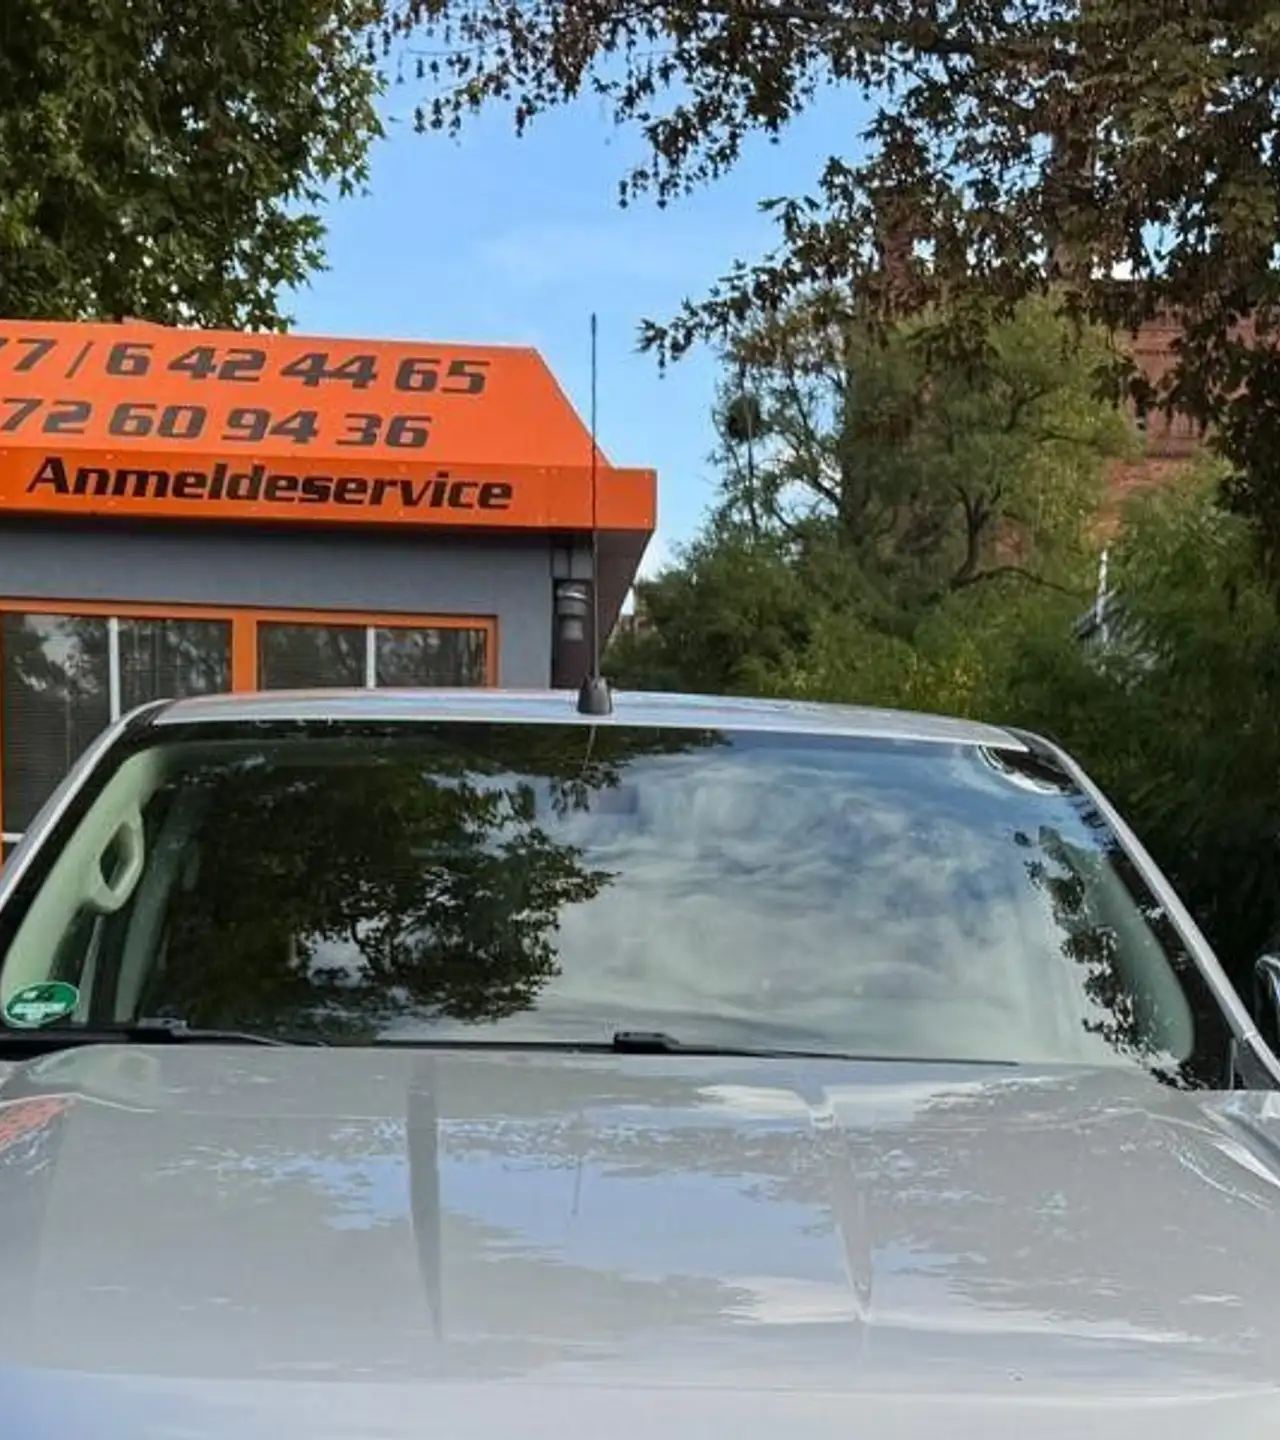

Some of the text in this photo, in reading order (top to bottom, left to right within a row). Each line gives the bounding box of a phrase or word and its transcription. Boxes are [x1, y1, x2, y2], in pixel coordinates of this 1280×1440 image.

[64, 340, 93, 379] /
[104, 342, 154, 377] 6
[167, 345, 267, 382] 42
[279, 352, 378, 389] 44
[394, 357, 491, 395] 65
[0, 397, 93, 435] 72
[108, 402, 207, 439] 60
[221, 406, 319, 443] 94
[336, 412, 433, 448] 36
[26, 456, 513, 510] Anmeldeservice
